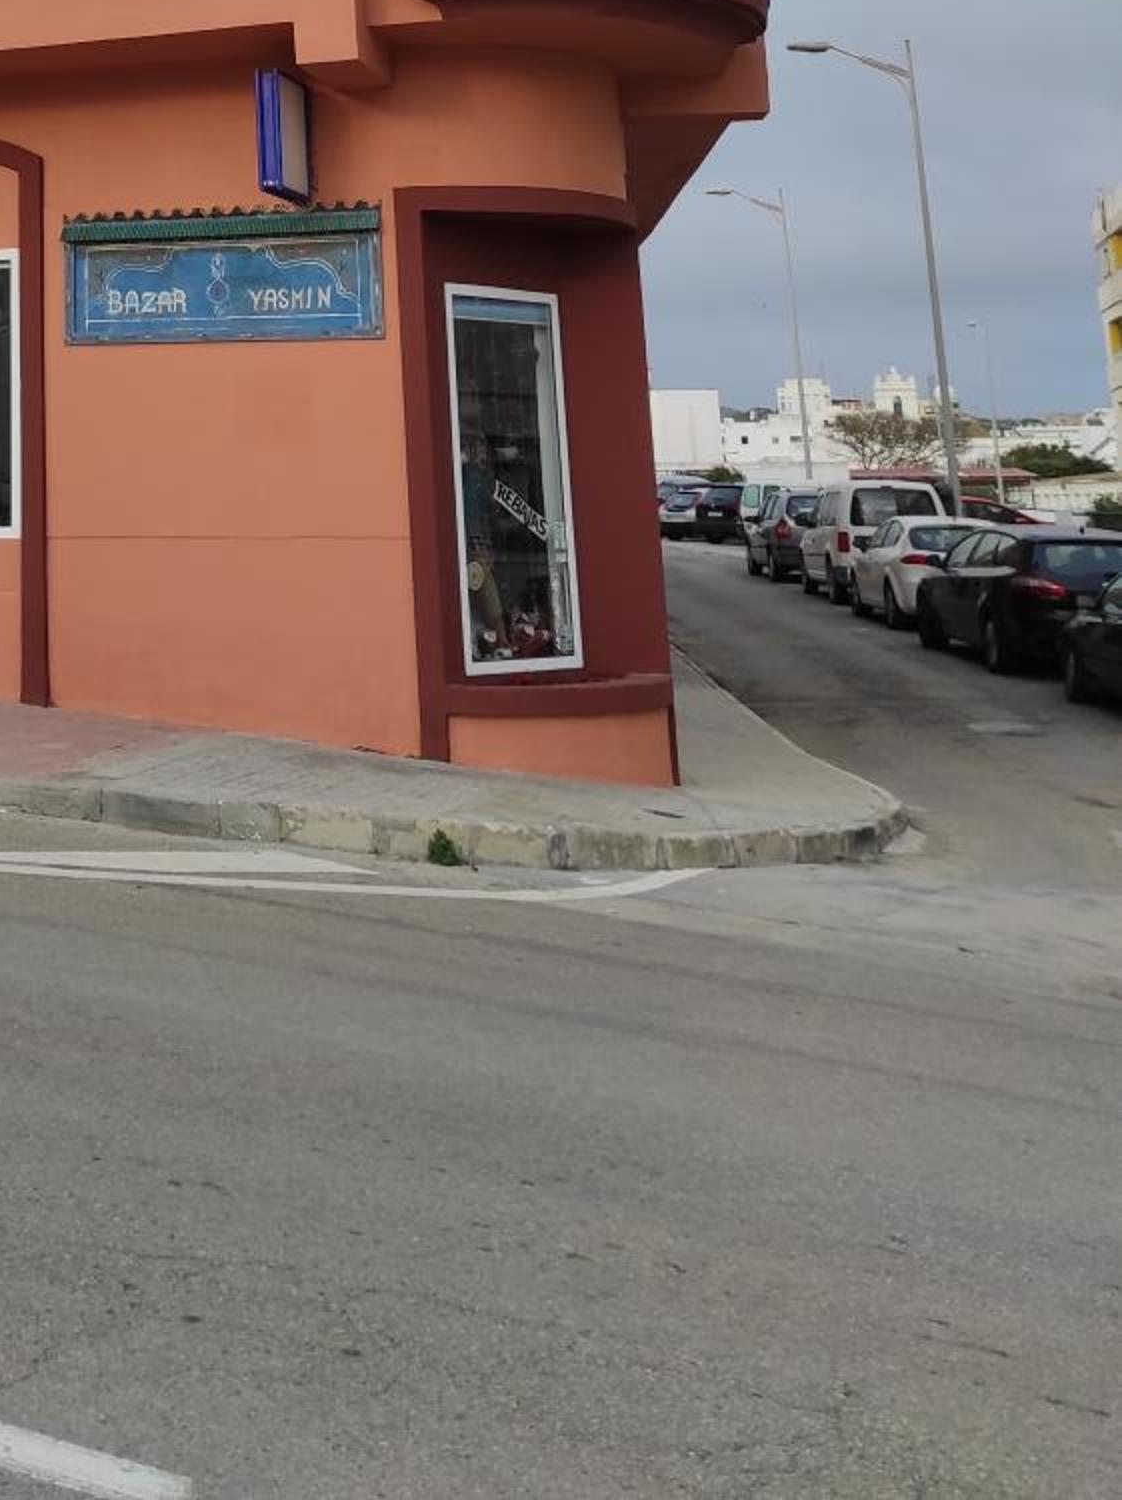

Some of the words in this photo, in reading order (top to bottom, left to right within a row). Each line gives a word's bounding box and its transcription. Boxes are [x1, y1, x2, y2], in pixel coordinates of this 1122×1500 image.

[108, 288, 188, 315] BAZAR
[247, 284, 332, 311] YASMIN
[497, 482, 547, 537] REBAJAS
